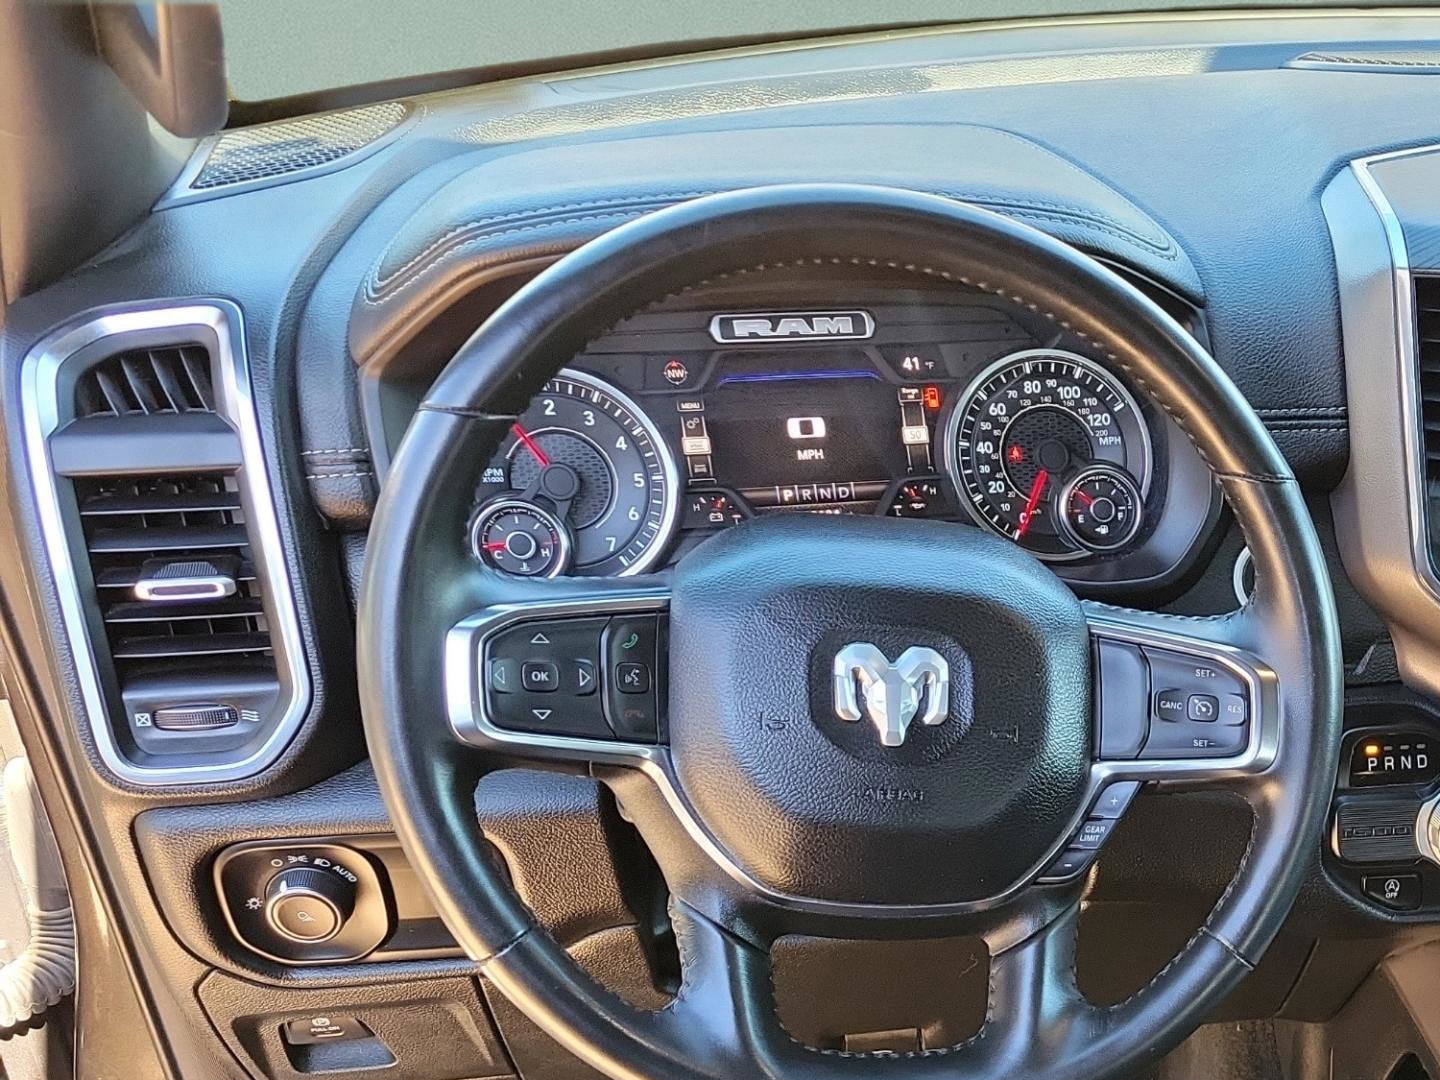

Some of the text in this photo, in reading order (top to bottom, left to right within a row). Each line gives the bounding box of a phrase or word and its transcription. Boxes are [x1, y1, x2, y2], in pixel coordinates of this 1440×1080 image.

[732, 316, 853, 337] RAM
[902, 356, 920, 371] 41
[667, 367, 685, 378] NW
[1024, 381, 1041, 394] 80
[1045, 379, 1057, 388] 90
[1006, 390, 1018, 399] 70
[1057, 386, 1081, 400] 100
[543, 400, 556, 415] 2
[1083, 398, 1097, 406] 110
[989, 403, 1006, 416] 60
[583, 411, 595, 426] 3
[1088, 413, 1111, 427] 120
[786, 417, 826, 439] 0
[980, 422, 992, 430] 50
[615, 436, 627, 450] 4
[1099, 436, 1121, 446] MPH
[976, 442, 993, 454] 40
[797, 449, 824, 460] MPH
[979, 465, 990, 473] 30
[634, 473, 645, 487] 5
[988, 481, 1005, 494] 20
[783, 487, 849, 501] P R N D
[629, 506, 640, 520] 6
[1078, 515, 1084, 523] E
[1118, 513, 1124, 521] F
[606, 537, 616, 551] 7
[494, 551, 503, 559] C
[541, 549, 550, 557] H
[531, 671, 549, 682] OK
[1160, 701, 1183, 710] CANC
[1227, 705, 1242, 714] RES
[1368, 755, 1428, 771] P R N D
[1085, 825, 1105, 833] GEAR
[333, 864, 358, 883] AUTO
